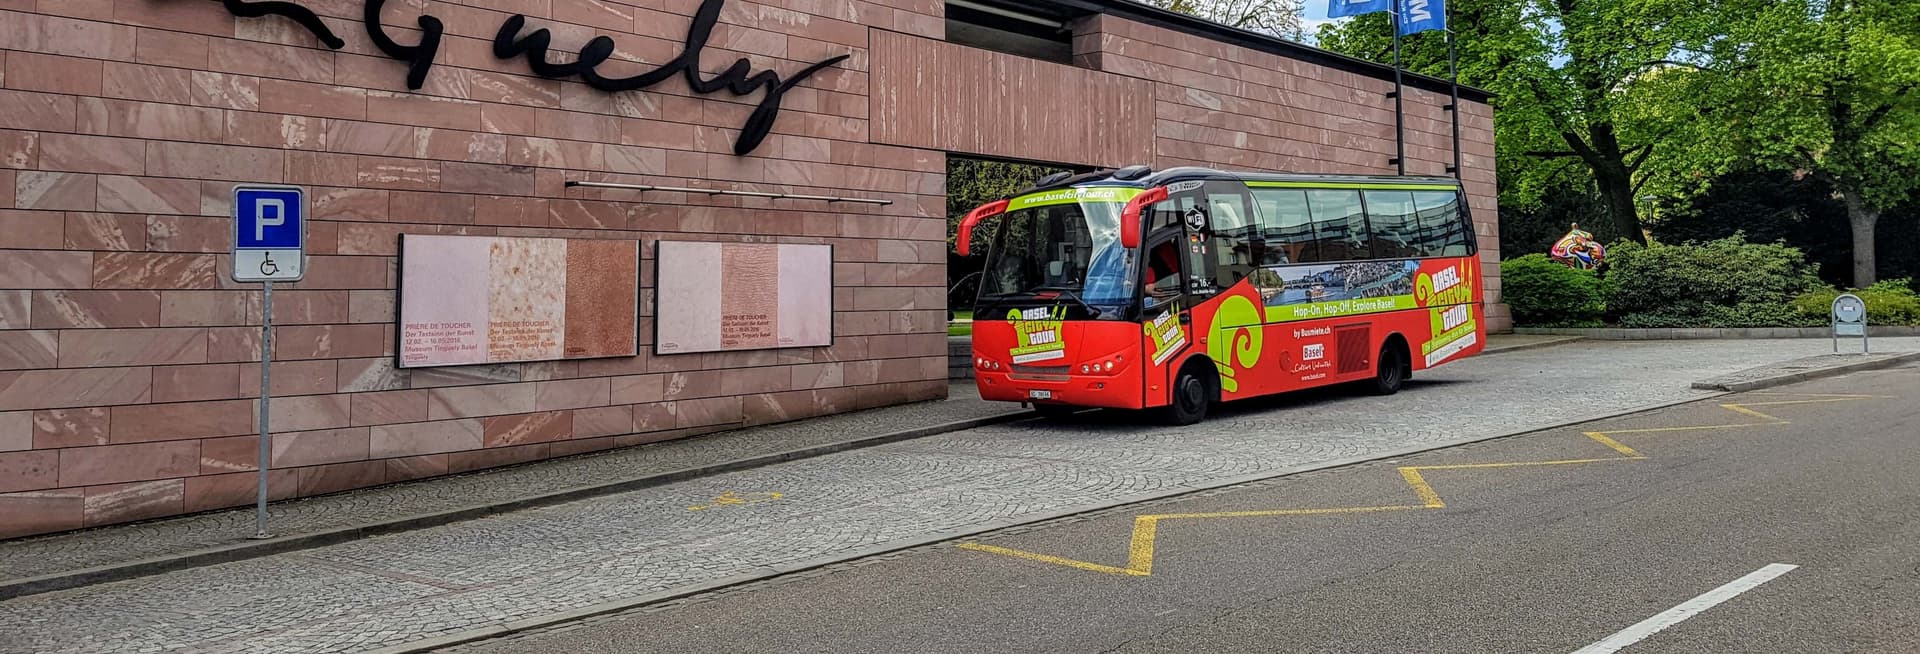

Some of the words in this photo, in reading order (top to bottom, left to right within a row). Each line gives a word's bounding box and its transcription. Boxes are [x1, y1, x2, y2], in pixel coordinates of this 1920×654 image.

[255, 198, 285, 241] P
[1432, 265, 1461, 293] BASEL
[1437, 285, 1461, 312] CITY
[1023, 307, 1050, 320] BASEL
[1294, 304, 1322, 317] Hop-On,
[1324, 301, 1351, 315] Hop-Off,
[1353, 299, 1376, 312] Explore
[1377, 298, 1395, 309] Basel!
[1153, 309, 1171, 328] BASEL
[1442, 304, 1468, 331] TOUR
[440, 321, 471, 330] TOUCHER
[1025, 319, 1051, 333] CITY
[1294, 329, 1301, 339] by
[1301, 326, 1331, 337] Busmiete.ch
[1029, 330, 1056, 345] TOUR
[434, 344, 460, 352] Tinguely
[1304, 345, 1323, 358] Basel
